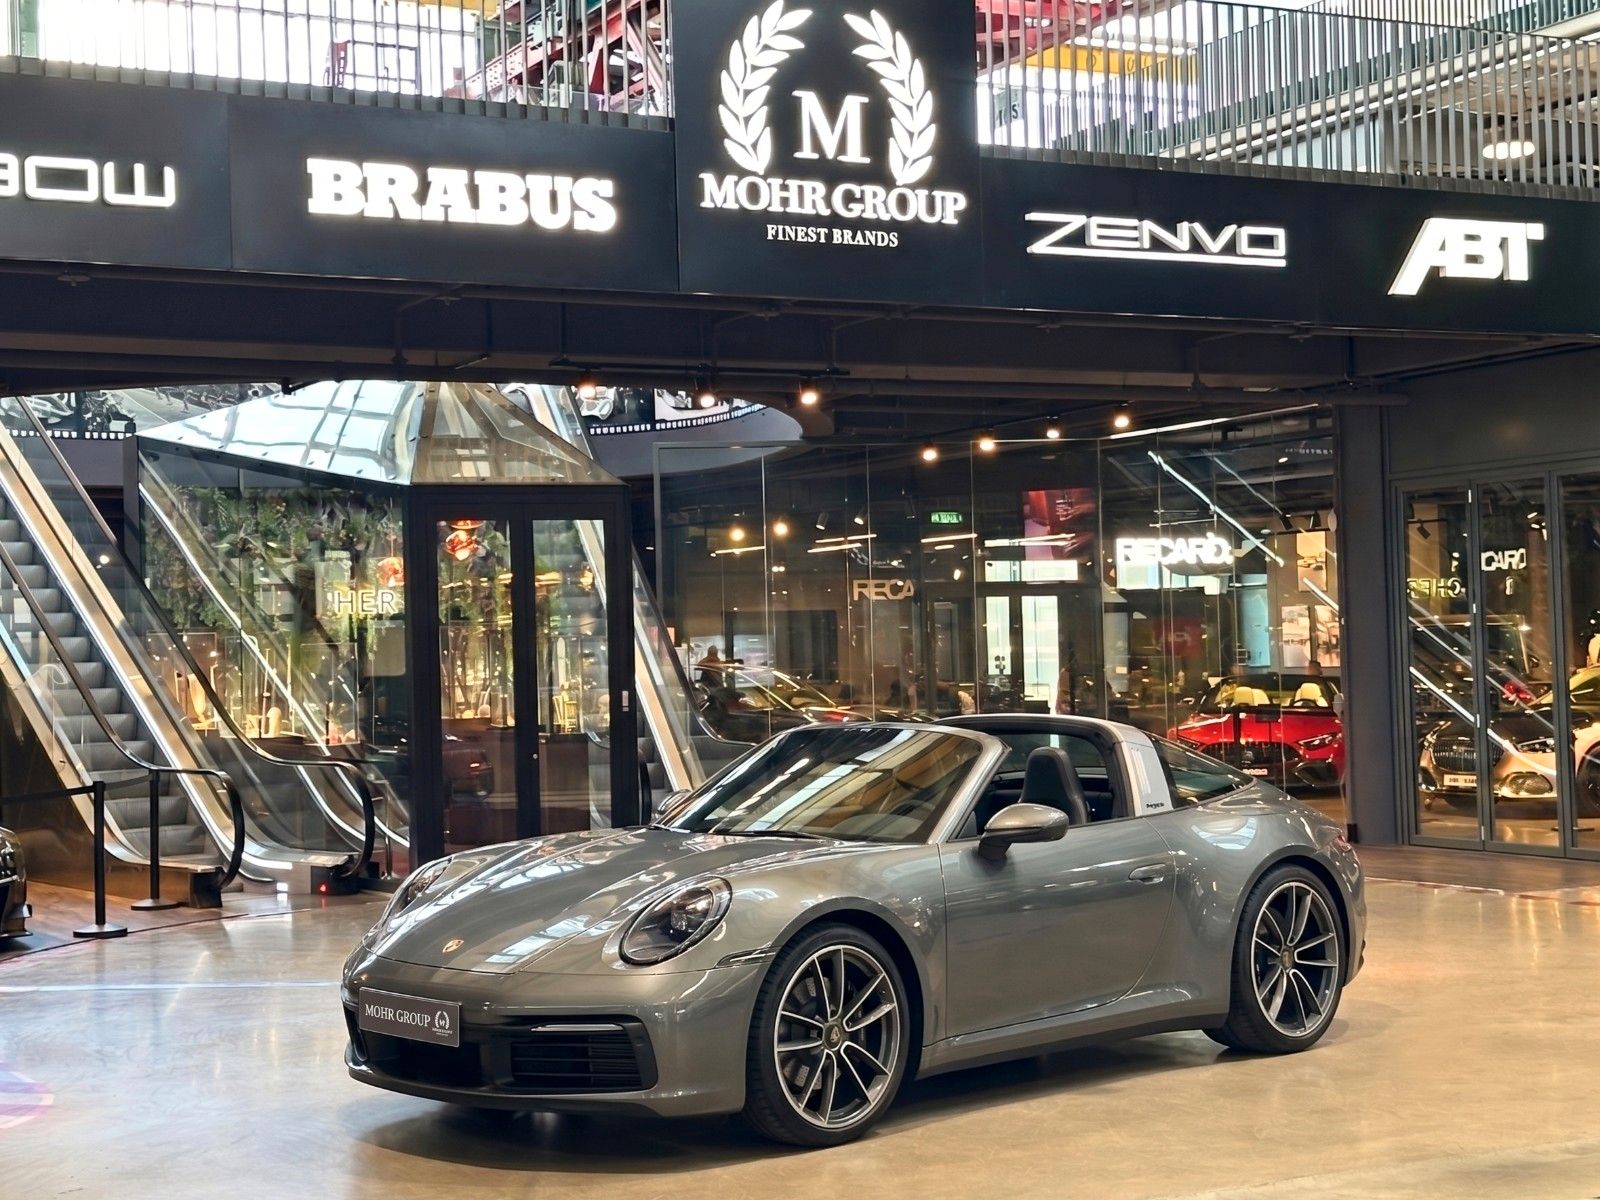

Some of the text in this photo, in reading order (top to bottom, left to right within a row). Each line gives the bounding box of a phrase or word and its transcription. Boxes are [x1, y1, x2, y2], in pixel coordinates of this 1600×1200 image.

[791, 90, 871, 164] M
[0, 152, 176, 208] OW
[306, 157, 618, 233] BRABUS
[698, 173, 967, 225] MOHR GROUP
[766, 224, 899, 248] FINEST BRANDS
[1024, 212, 1287, 267] ZENVO
[1387, 217, 1545, 296] ABT
[364, 1003, 431, 1028] MOHR GROUP
